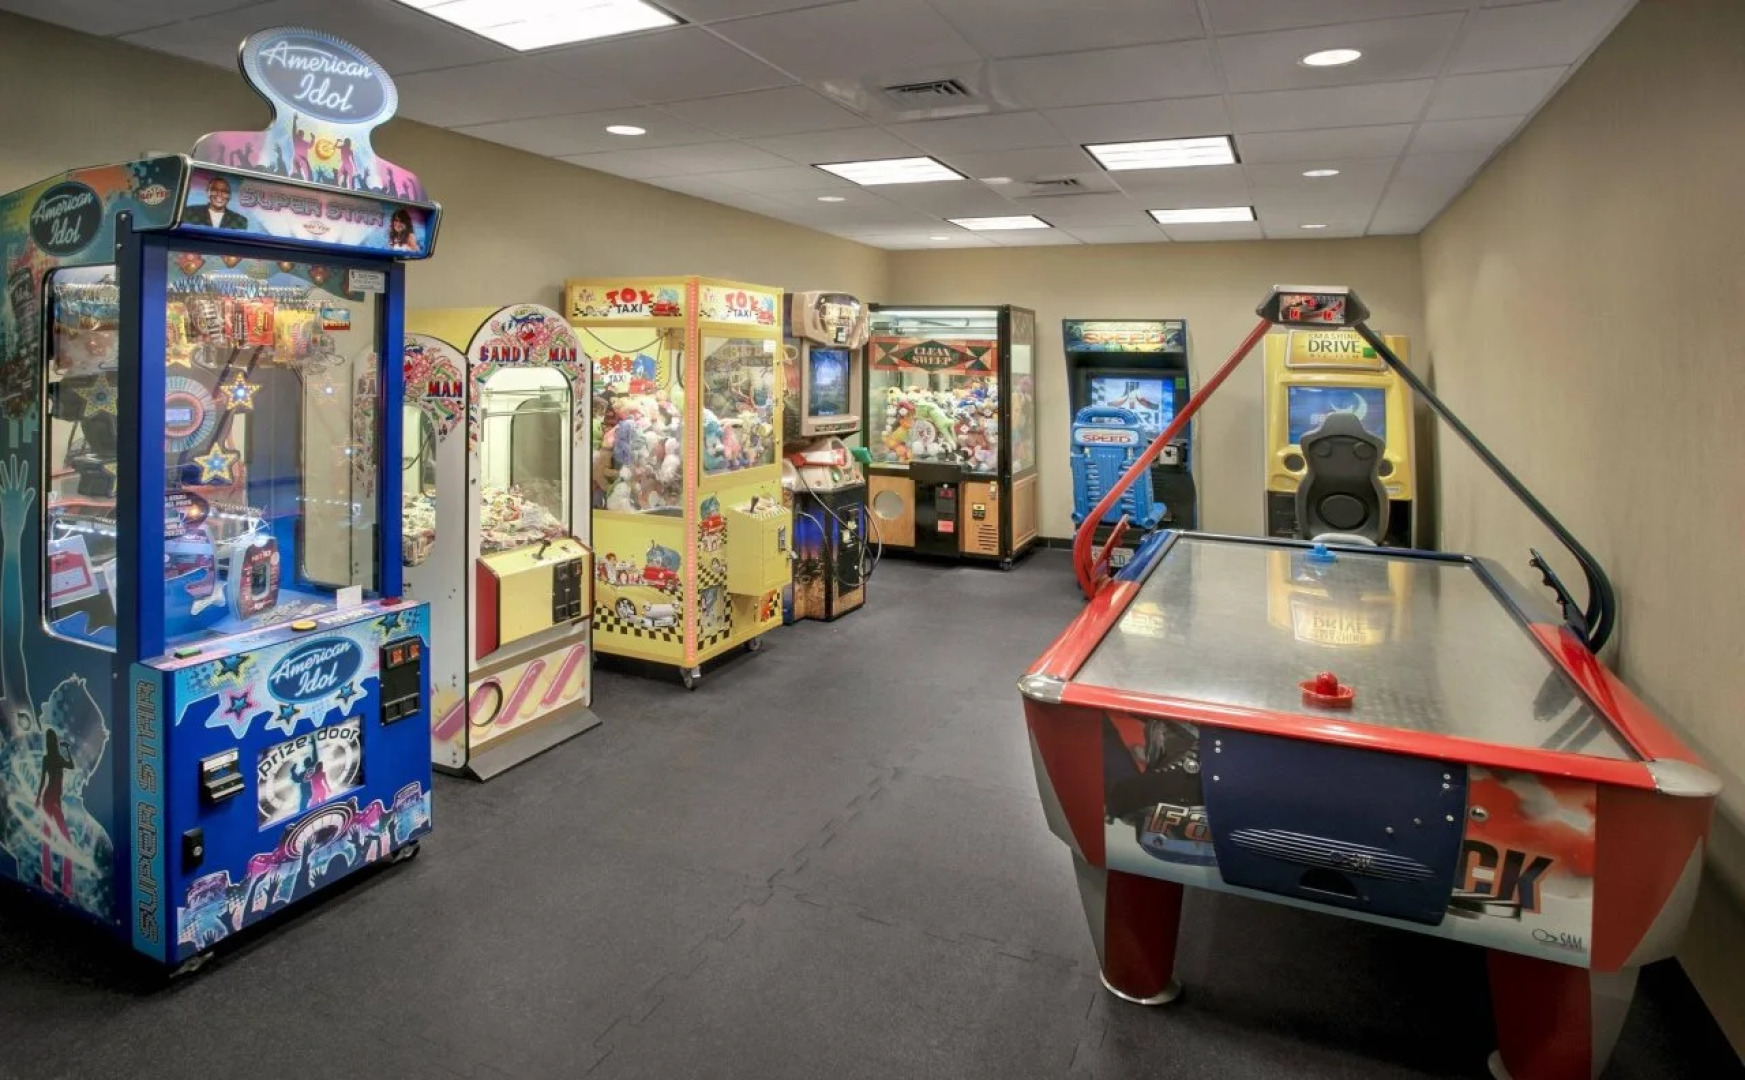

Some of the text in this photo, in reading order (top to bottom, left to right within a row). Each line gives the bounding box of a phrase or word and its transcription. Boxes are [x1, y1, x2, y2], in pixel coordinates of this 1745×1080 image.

[259, 41, 372, 78] American
[295, 74, 353, 110] Idol
[32, 192, 93, 221] American
[239, 187, 384, 226] SUPER STAR
[48, 216, 82, 245] Idol
[606, 287, 654, 306] TOY
[616, 303, 643, 314] TAXI
[725, 291, 759, 315] TOY
[732, 309, 752, 318] TAXI
[548, 348, 577, 362] MAN
[1308, 340, 1361, 353] DRIVE
[427, 381, 463, 397] MAN
[1083, 433, 1131, 443] SPEED
[270, 641, 350, 684] American
[294, 662, 339, 697] Idol
[258, 726, 360, 777] prize door
[136, 680, 159, 944] SUPER STAR
[1560, 932, 1582, 949] SAM
